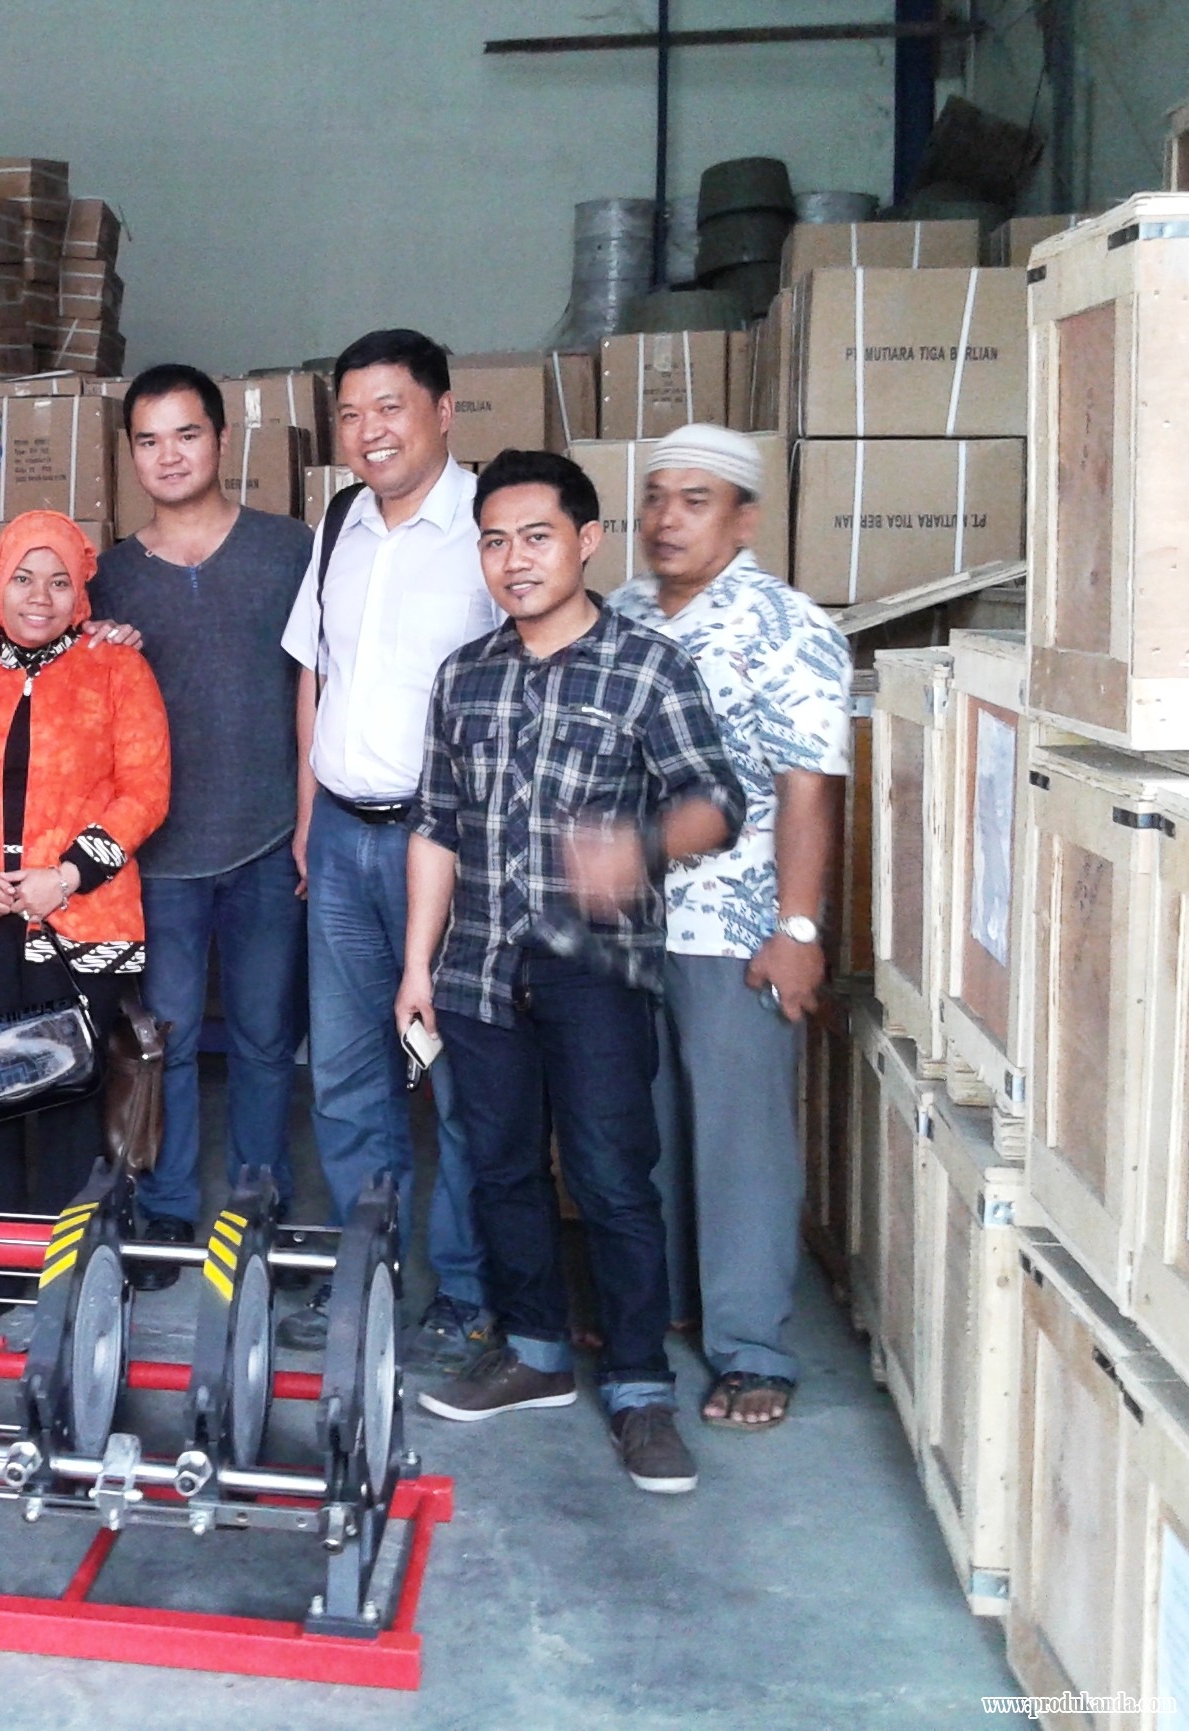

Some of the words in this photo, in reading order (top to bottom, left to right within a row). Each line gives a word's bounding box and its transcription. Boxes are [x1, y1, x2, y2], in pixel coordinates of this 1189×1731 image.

[864, 347, 915, 361] MUTIARA
[920, 347, 945, 361] TIGA
[950, 347, 997, 361] BRLIAN
[454, 400, 492, 412] BERLIAN
[834, 515, 882, 529] BERIAN
[886, 514, 912, 529] TIGA
